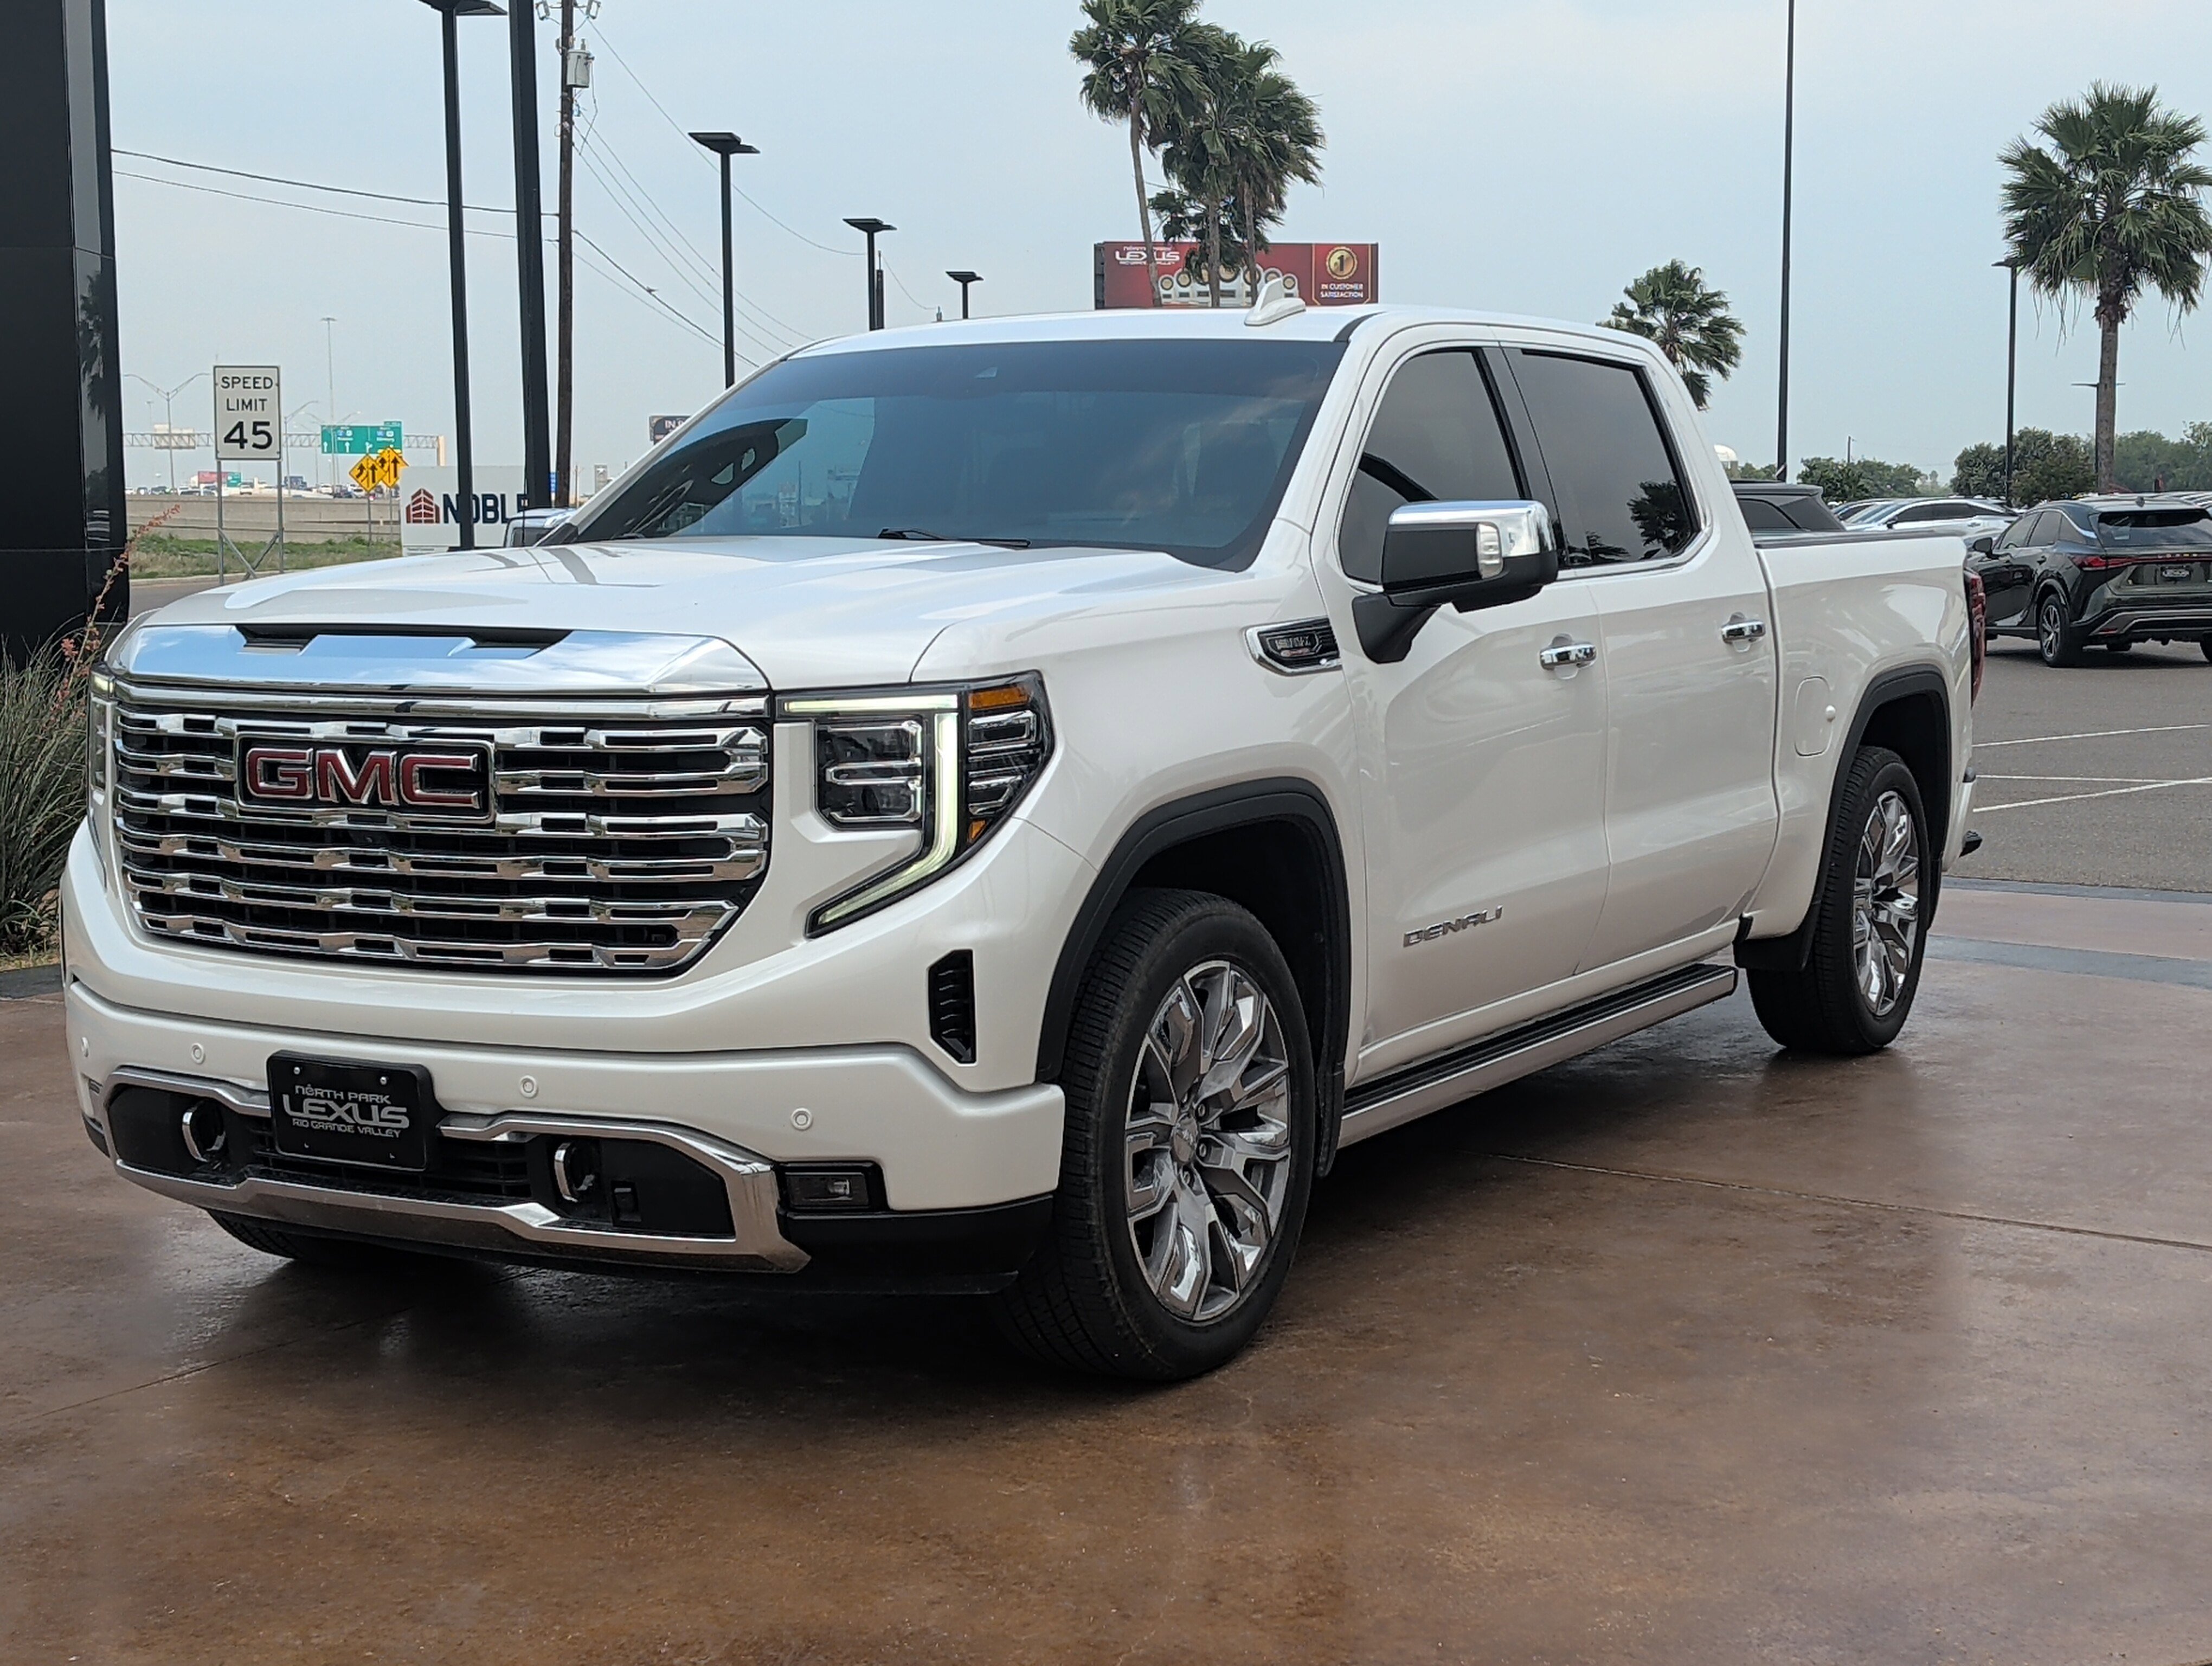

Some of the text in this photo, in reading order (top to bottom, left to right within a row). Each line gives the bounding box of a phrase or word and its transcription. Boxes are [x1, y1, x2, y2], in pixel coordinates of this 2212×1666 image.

[1338, 255, 1345, 271] 1
[221, 376, 273, 389] SPEED
[226, 398, 268, 411] LIMIT
[223, 421, 273, 450] 45
[246, 747, 480, 810] GMC
[1403, 905, 1503, 948] DENALI
[348, 1091, 391, 1105] PARK
[282, 1093, 410, 1129] LEXUS
[292, 1118, 401, 1138] RIO GRANDE VALLEY
